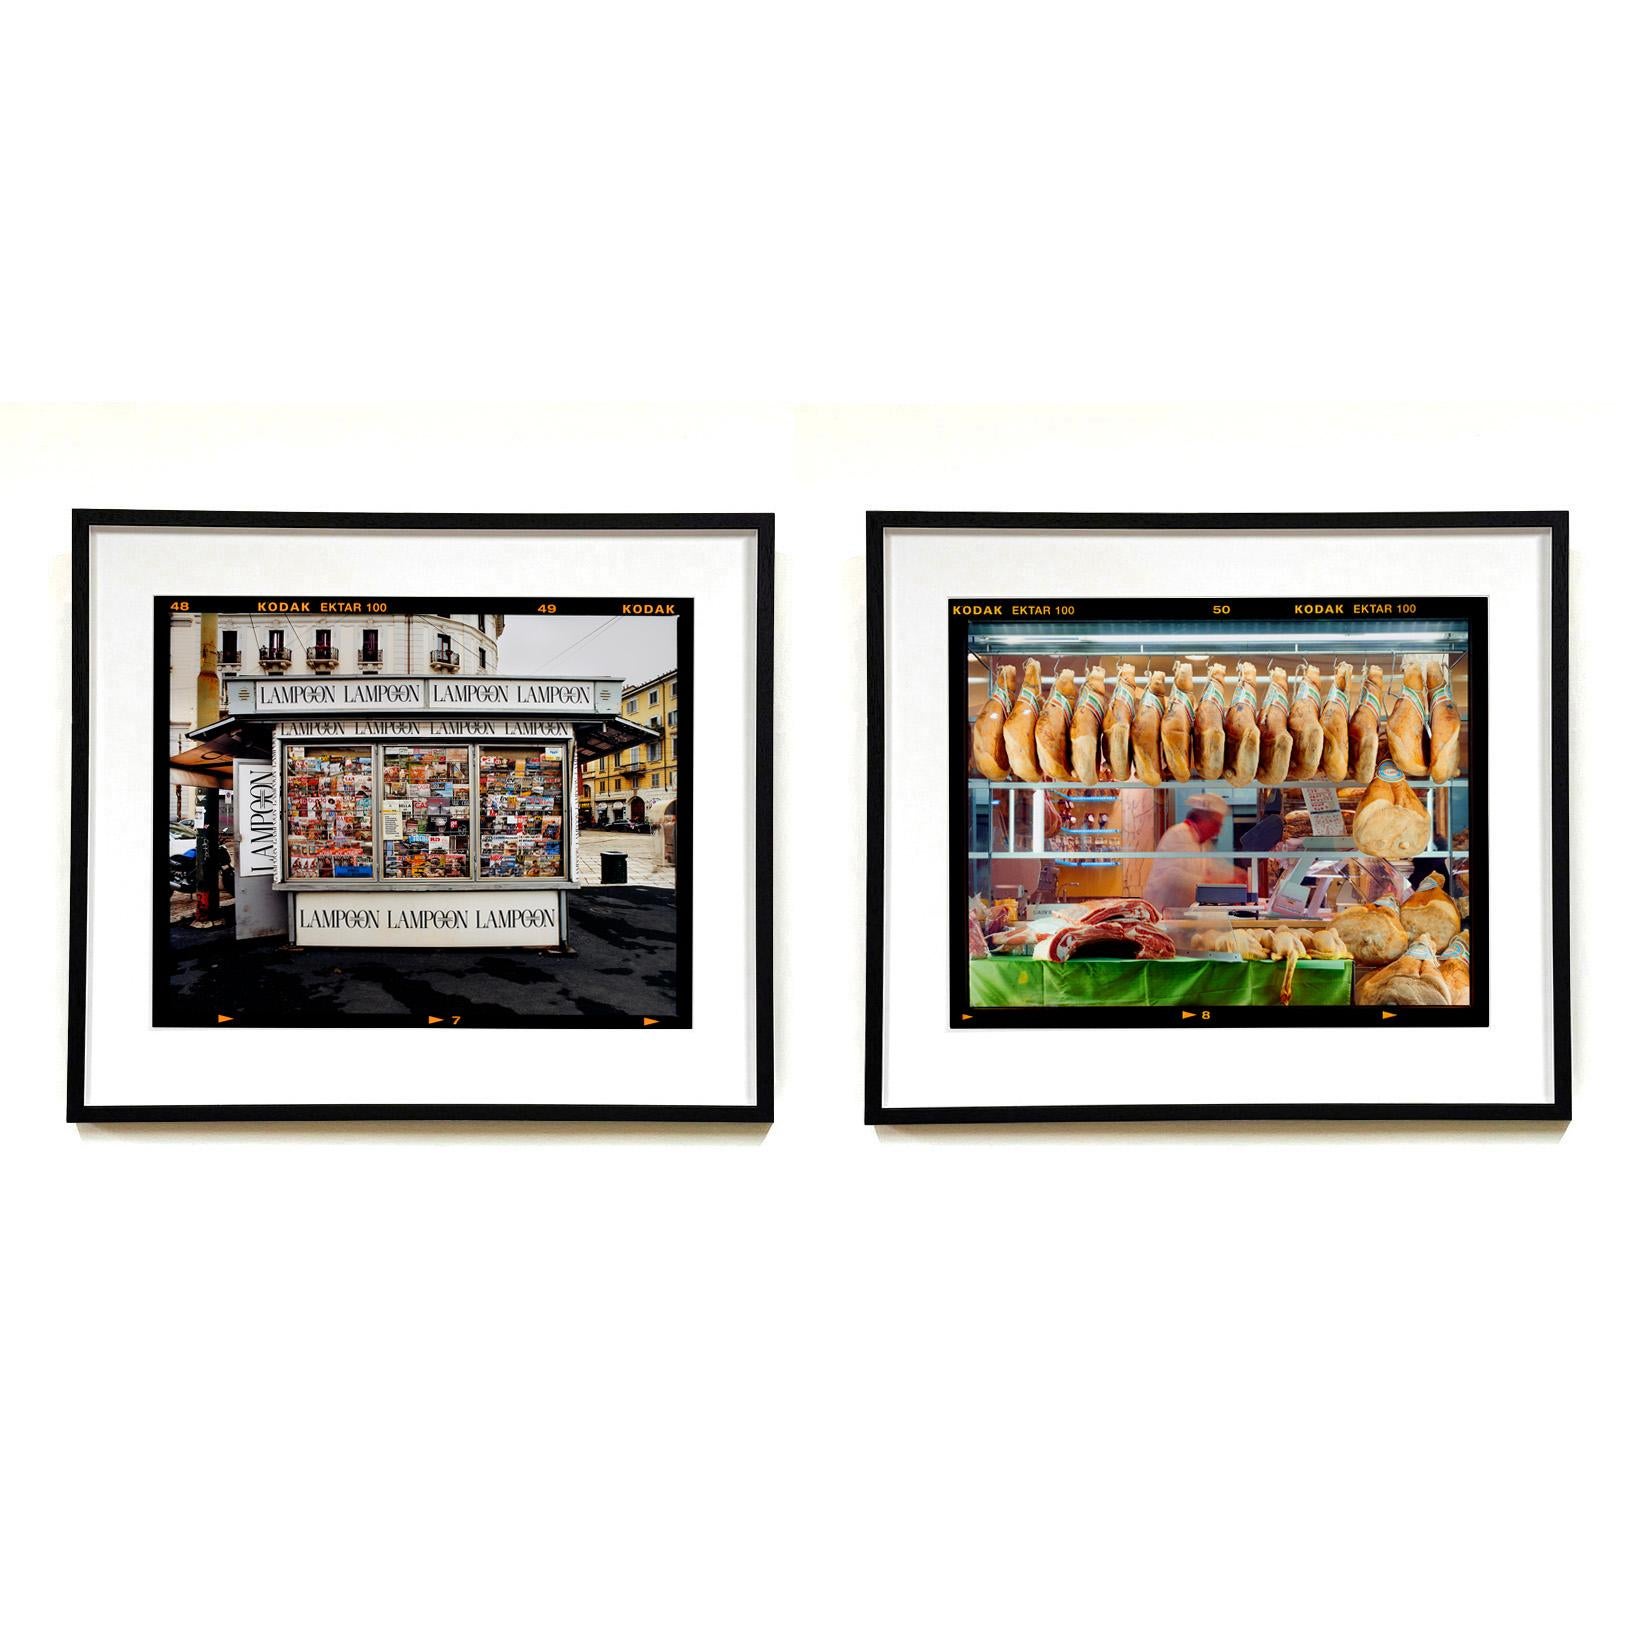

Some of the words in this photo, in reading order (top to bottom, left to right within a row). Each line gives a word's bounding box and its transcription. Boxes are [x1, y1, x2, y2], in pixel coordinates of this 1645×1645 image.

[170, 601, 190, 611] 48
[257, 601, 310, 612] KODAK
[320, 602, 362, 612] EKTAR
[366, 602, 387, 612] 100
[537, 604, 557, 614] 49
[622, 604, 676, 614] KODAK
[953, 605, 1003, 615] KODAK
[1012, 605, 1051, 615] EKTAR
[1055, 605, 1075, 615] 100
[1212, 605, 1231, 614] 50
[1294, 604, 1344, 614] KODAK
[1353, 604, 1393, 614] EKTAR
[1396, 604, 1417, 614] 100
[261, 685, 336, 704] LAMPOON
[344, 684, 420, 703] LAMPOON
[433, 685, 509, 703] LAMPOON
[517, 686, 591, 704] LAMPOON
[280, 721, 345, 736] LAMPOON
[354, 721, 420, 735] LAMPOON
[430, 721, 495, 735] LAMPOON
[504, 721, 570, 736] LAMPOON
[249, 769, 274, 872] LAMPOON
[299, 909, 380, 928] LAMPOON
[387, 909, 469, 928] LAMPOON
[476, 909, 555, 928] LAMPOON
[451, 1016, 462, 1025] 7
[1201, 1011, 1211, 1020] 8
